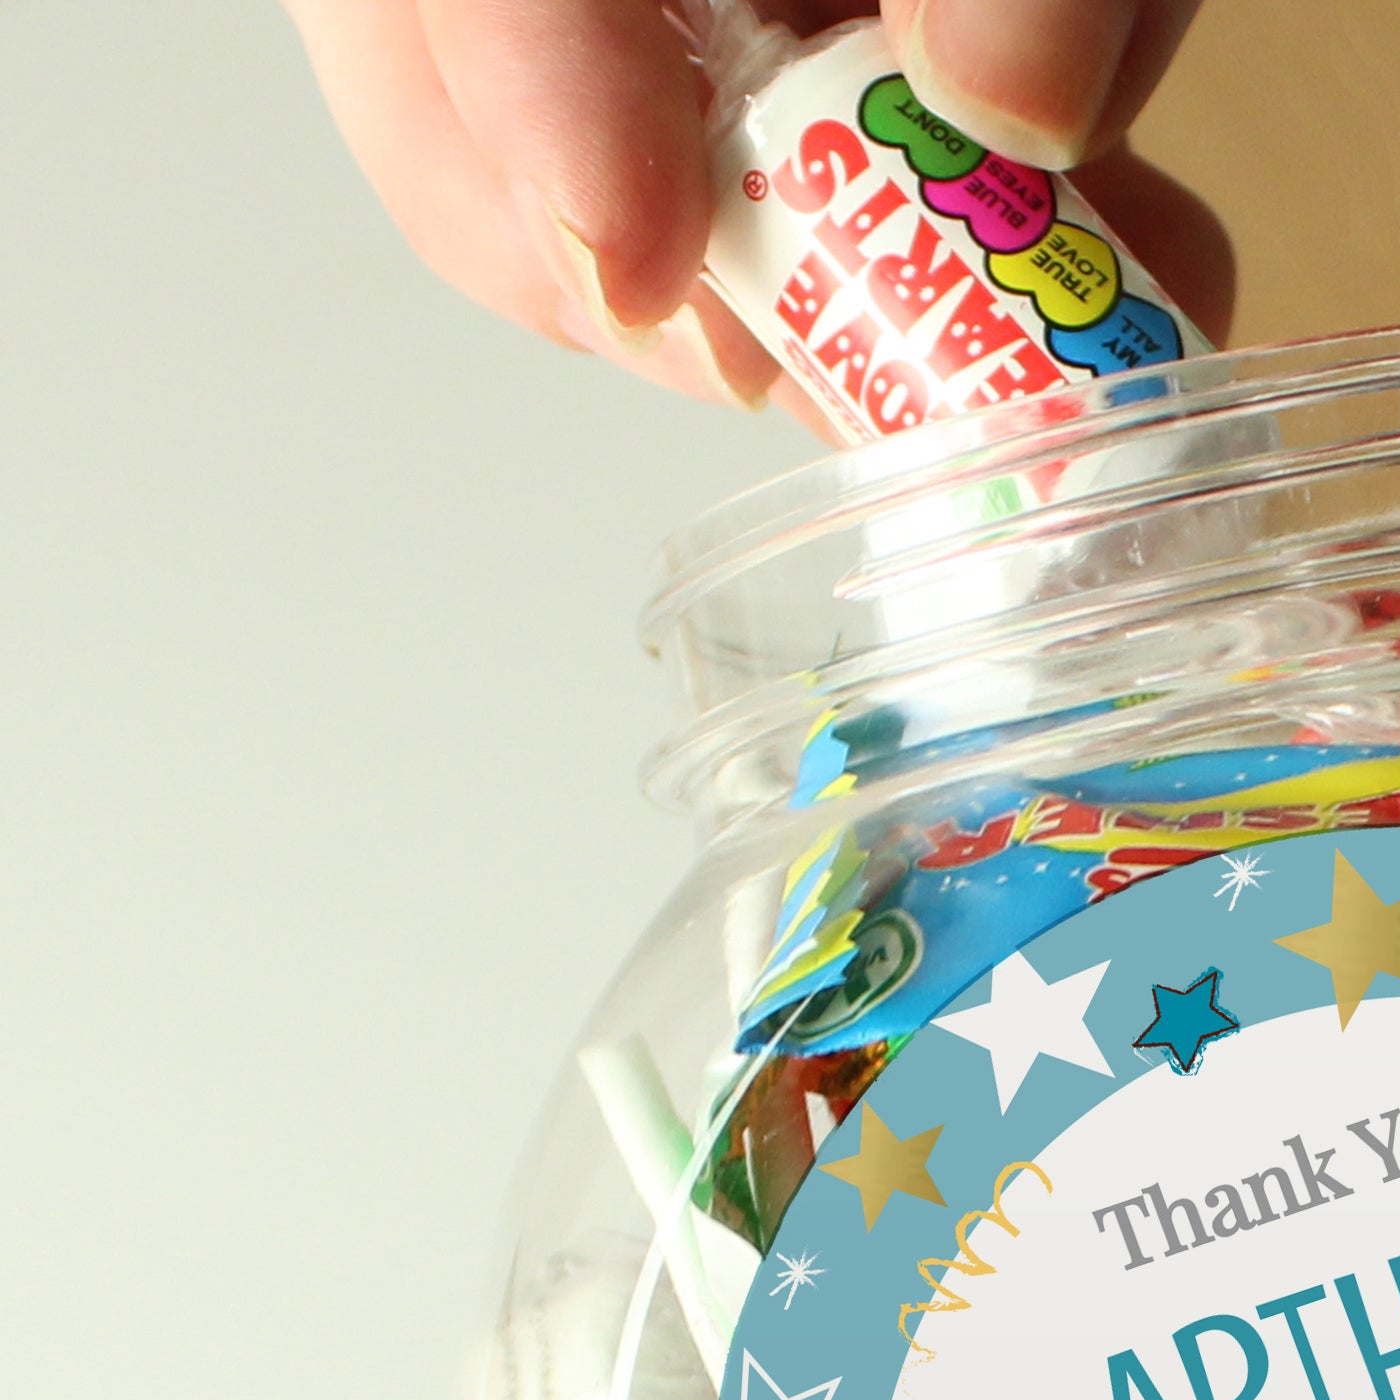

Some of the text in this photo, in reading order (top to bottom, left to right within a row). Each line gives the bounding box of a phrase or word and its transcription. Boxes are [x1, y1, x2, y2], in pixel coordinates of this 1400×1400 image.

[895, 99, 967, 156] DON'T
[964, 176, 1027, 229] BLUE
[986, 159, 1045, 212] EYES
[771, 119, 1076, 414] EARTS
[1030, 248, 1090, 303] TRUE
[1049, 234, 1109, 287] LOVE
[774, 250, 955, 434] OVE
[1101, 337, 1142, 368] MY
[1119, 314, 1165, 354] ALL
[1092, 1134, 1354, 1270] Thank
